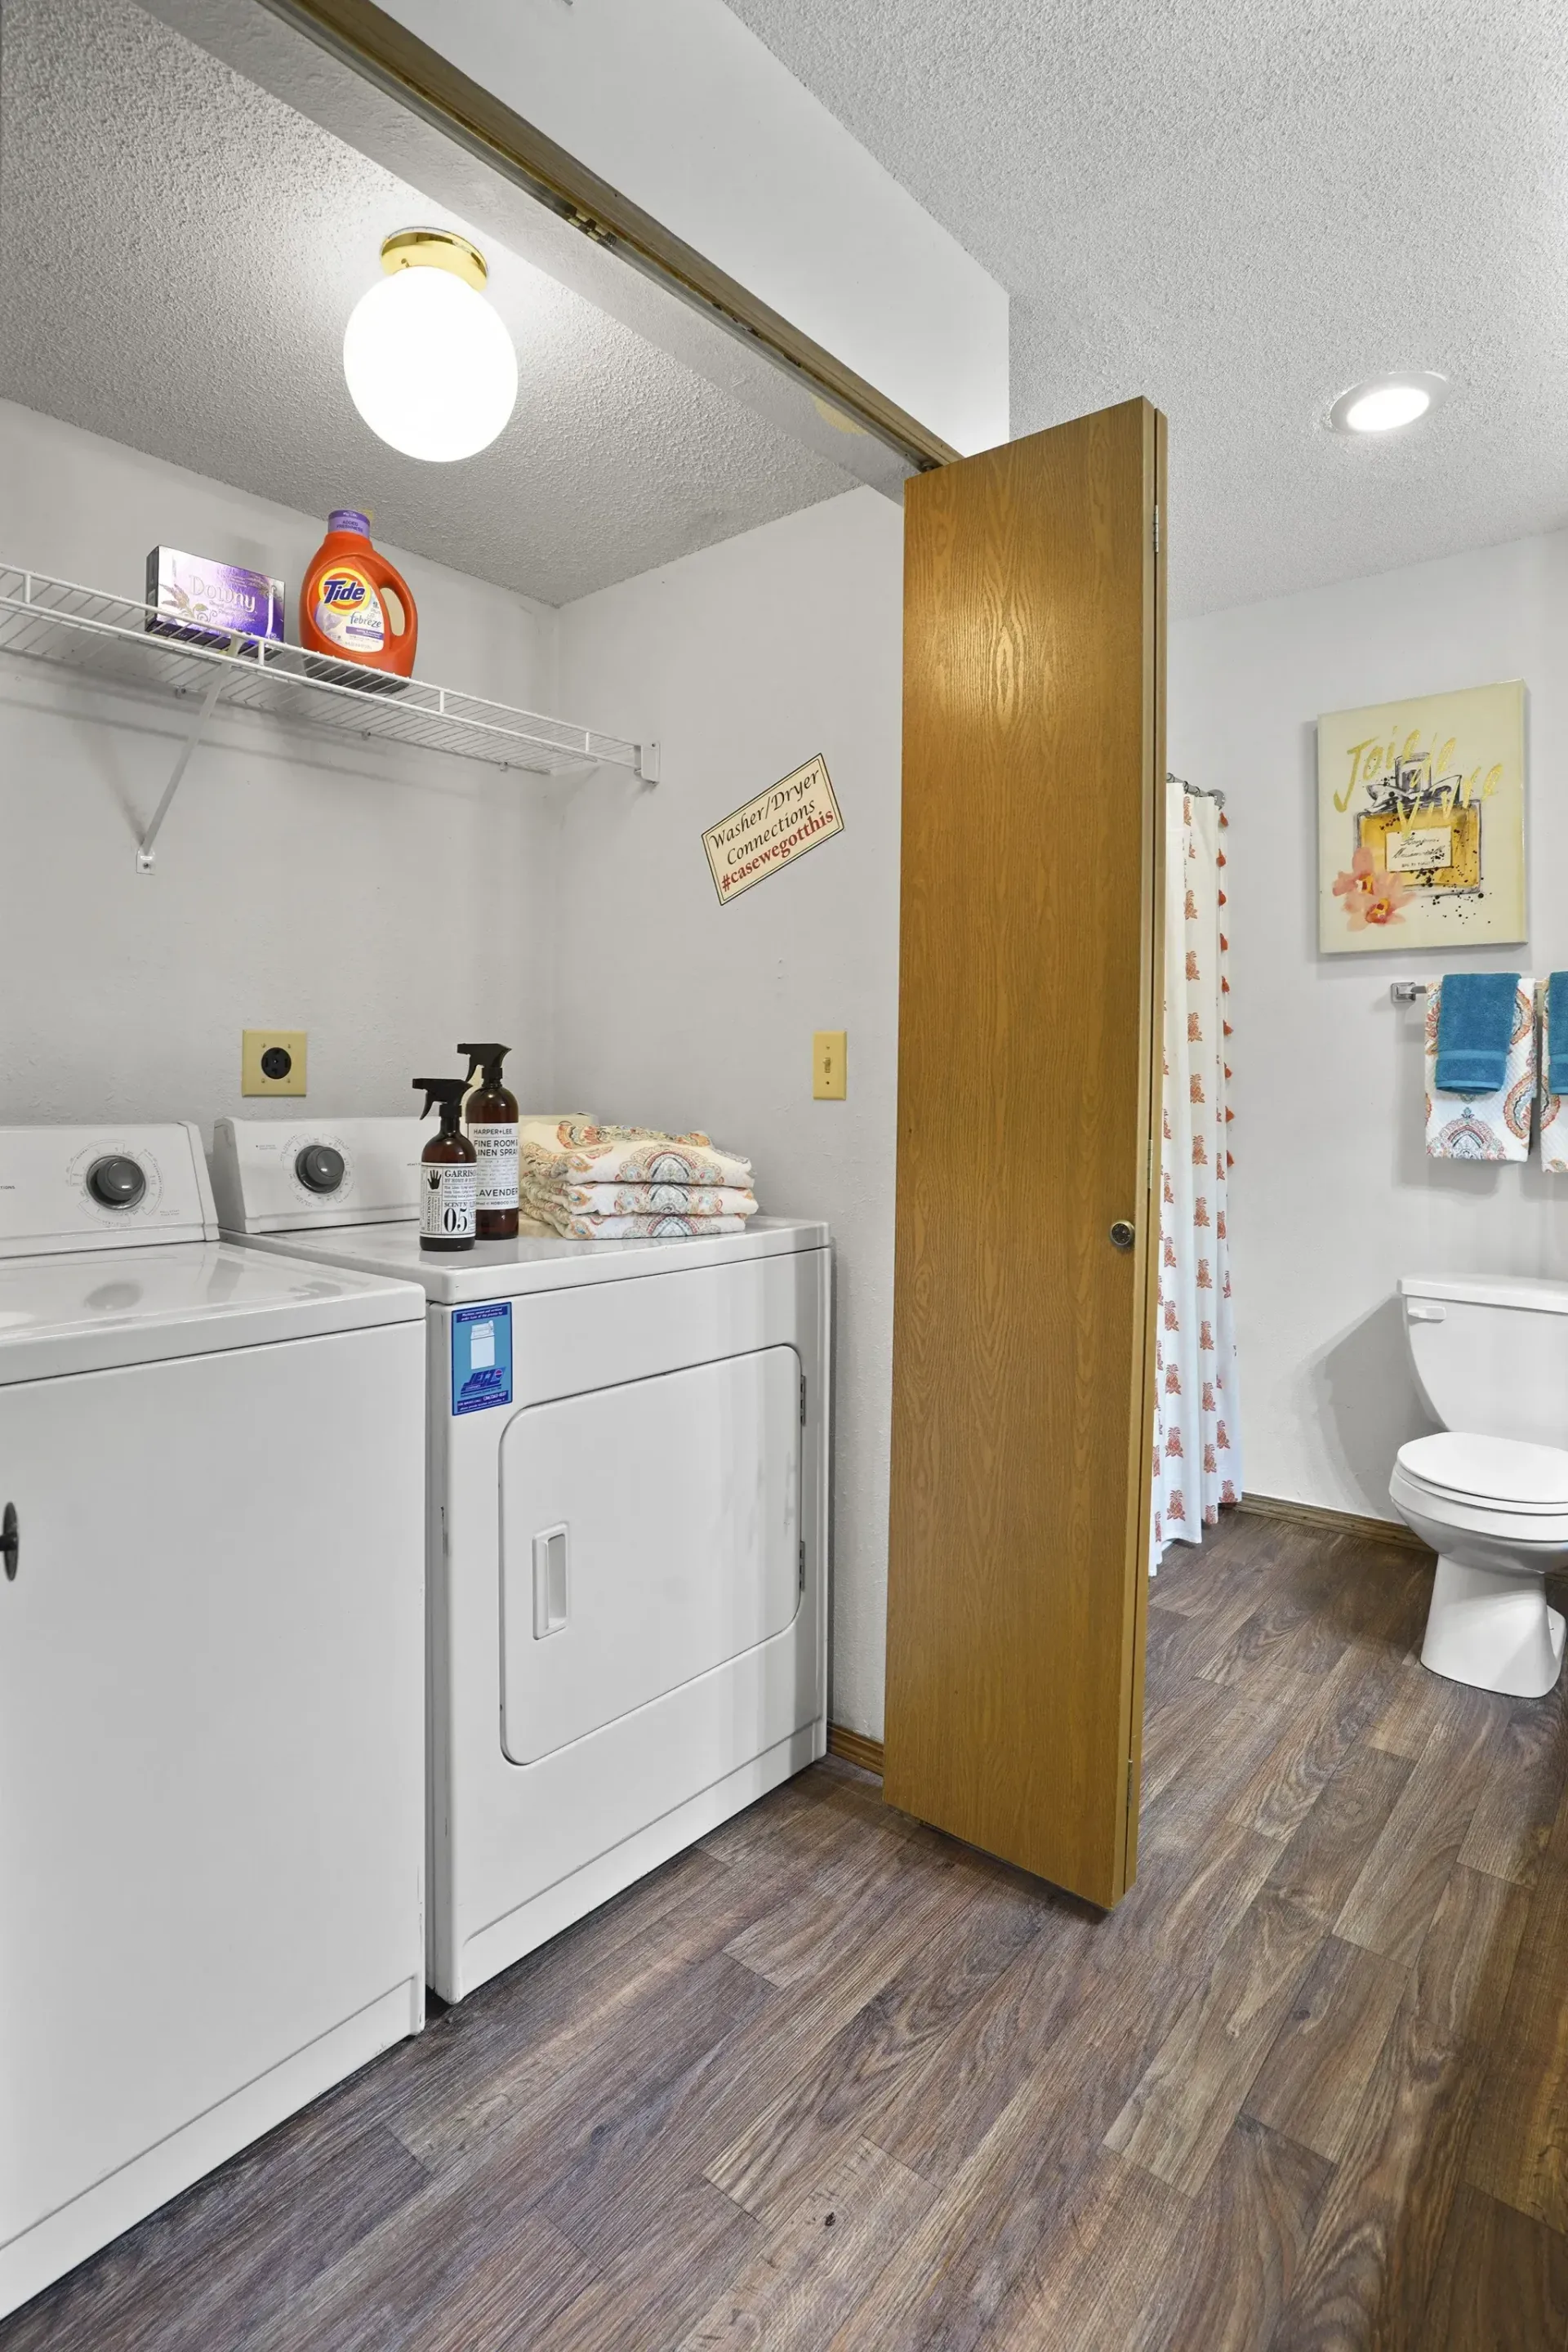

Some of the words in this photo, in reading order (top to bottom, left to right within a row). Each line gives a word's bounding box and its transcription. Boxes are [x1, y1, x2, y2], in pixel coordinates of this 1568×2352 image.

[188, 574, 256, 612] Downy
[323, 580, 366, 604] Tide
[350, 611, 381, 628] febreze
[1333, 725, 1420, 813] Joie
[708, 769, 819, 849] Washer/Dryer
[726, 799, 815, 866] Connections
[721, 810, 834, 893] #casewegotthis
[474, 1139, 492, 1147] FINE
[493, 1139, 515, 1147] ROOM
[476, 1188, 519, 1197] AVENDER
[443, 1207, 468, 1233] 05
